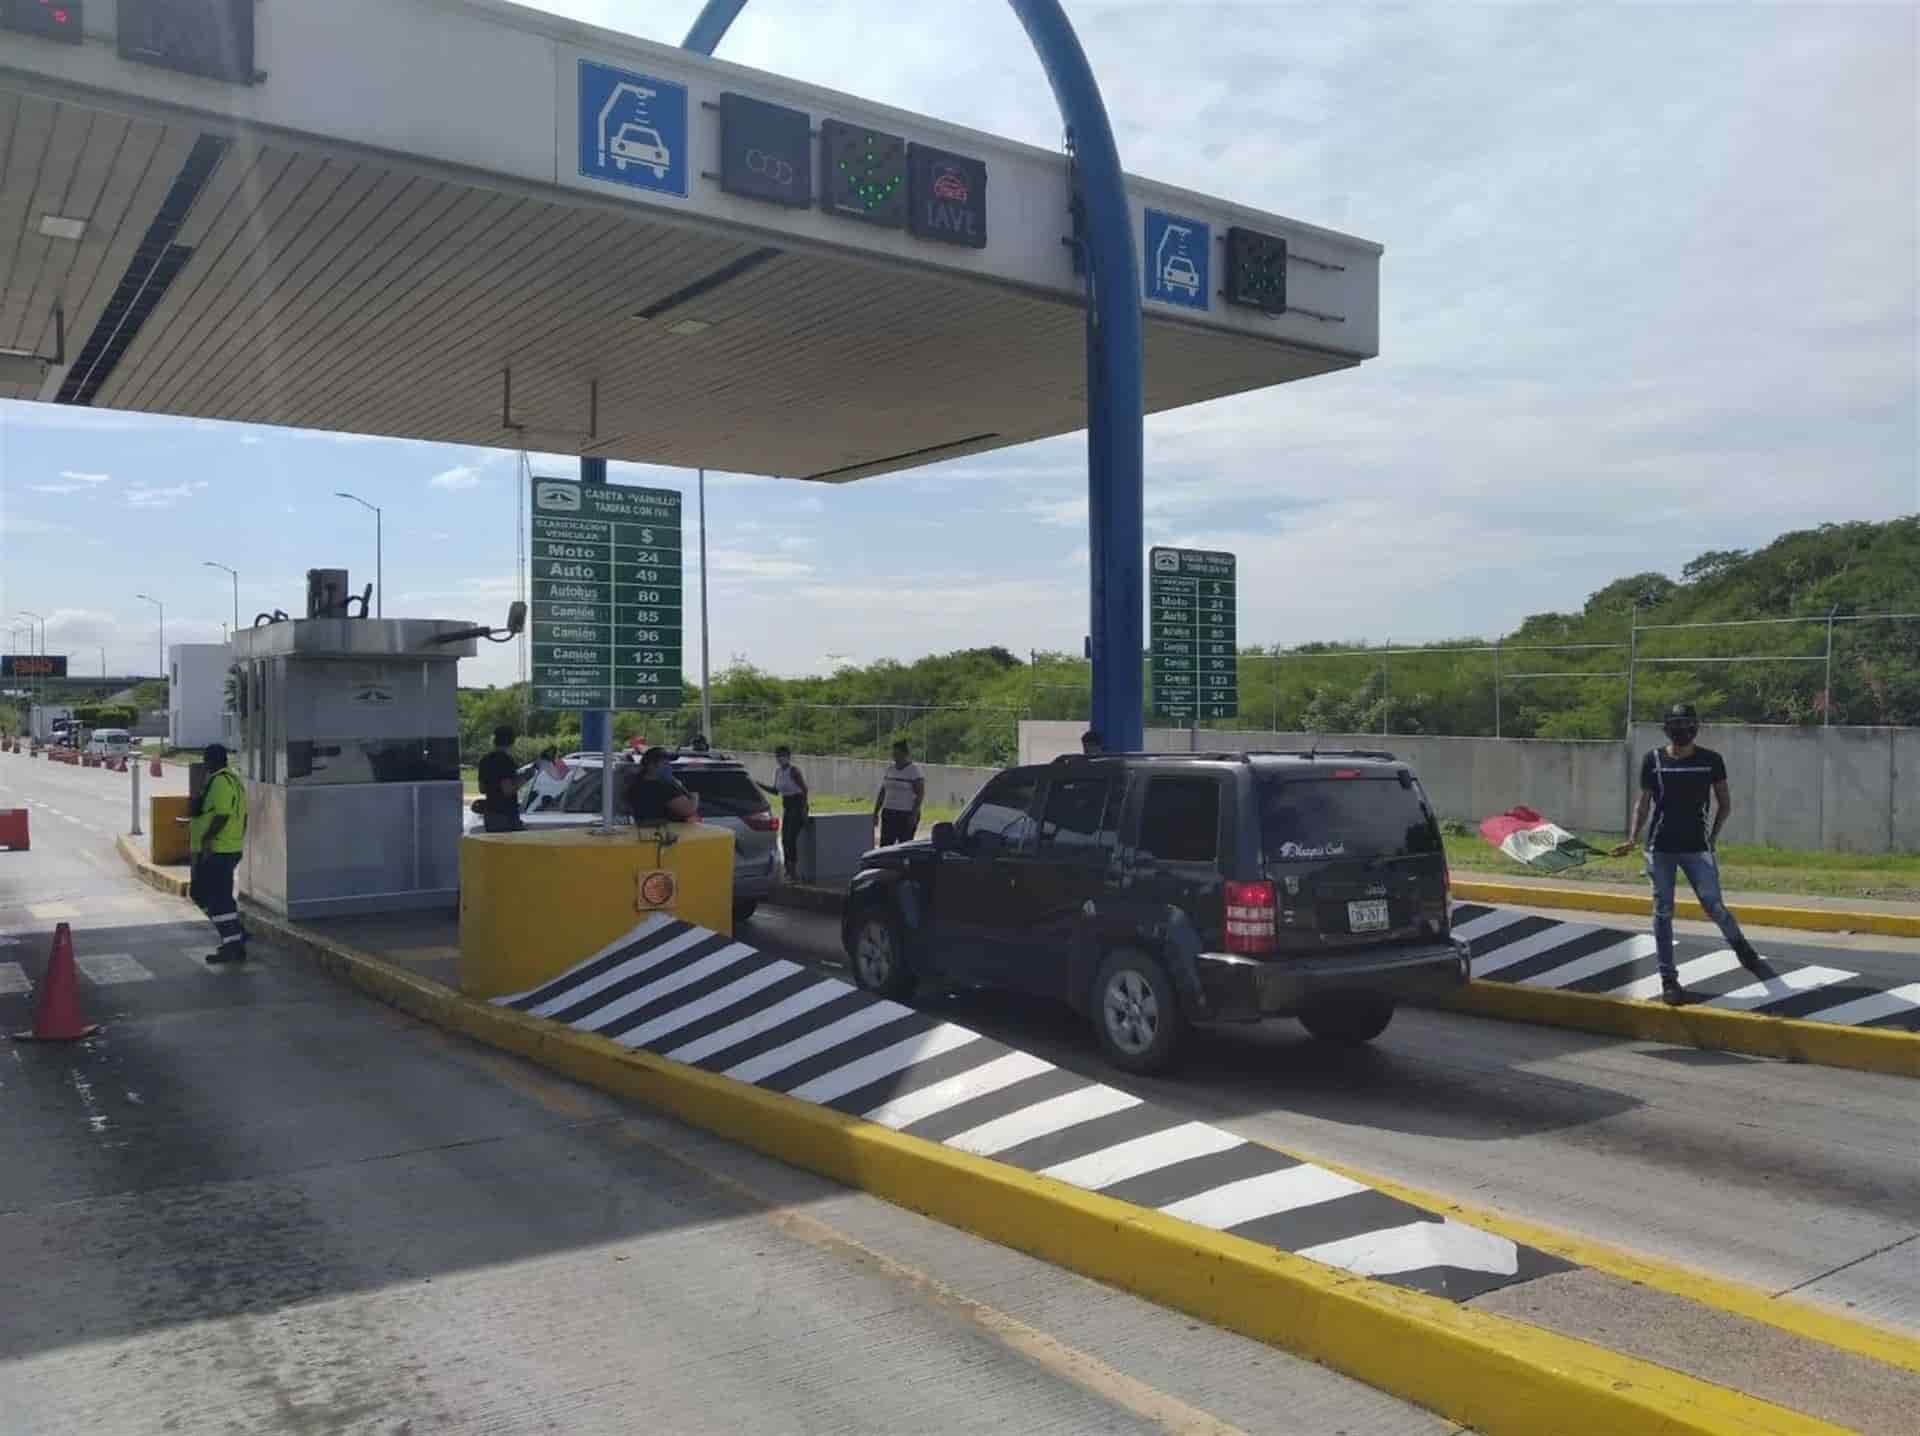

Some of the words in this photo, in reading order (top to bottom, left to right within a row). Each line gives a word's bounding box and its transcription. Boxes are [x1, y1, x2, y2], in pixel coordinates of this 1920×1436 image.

[641, 528, 654, 544] $
[548, 544, 595, 558] Moto
[637, 552, 659, 563] 24
[549, 563, 594, 578] Auto
[636, 570, 658, 582] 49
[638, 591, 660, 602] 80
[637, 610, 659, 622] 85
[637, 630, 659, 642] 96
[632, 651, 664, 664] 123
[637, 672, 659, 684] 24
[637, 694, 657, 705] 41
